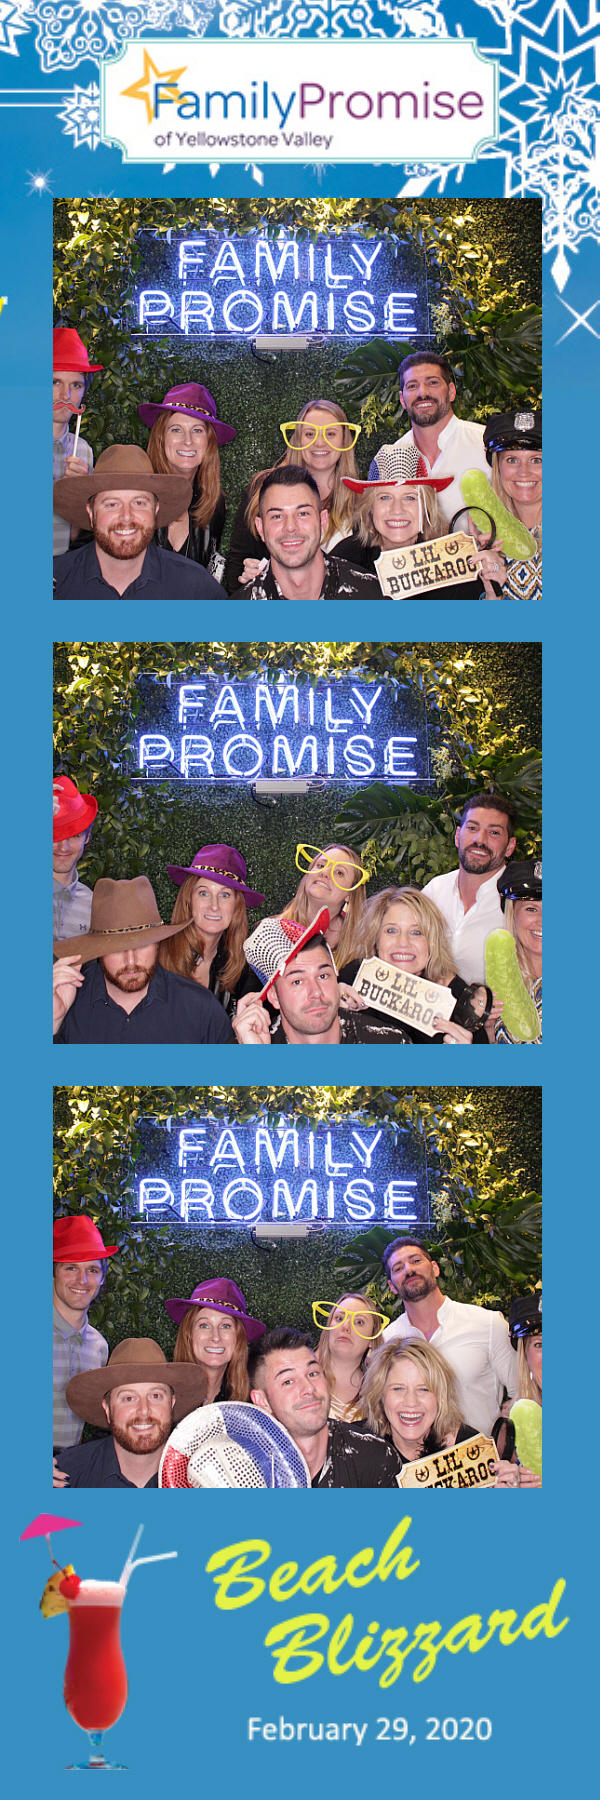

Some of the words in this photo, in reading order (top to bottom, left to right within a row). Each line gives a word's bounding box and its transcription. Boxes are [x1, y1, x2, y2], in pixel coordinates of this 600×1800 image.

[178, 240, 383, 288] FAMILY
[138, 289, 418, 333] PROMISE
[410, 542, 441, 568] LIL'
[178, 685, 383, 732] FAMILY
[138, 734, 418, 778] PROMISE
[391, 973, 422, 999] LIL'
[178, 1129, 383, 1176] FAMILY
[138, 1178, 418, 1222] PROMISE
[433, 1449, 463, 1478] LIL'
